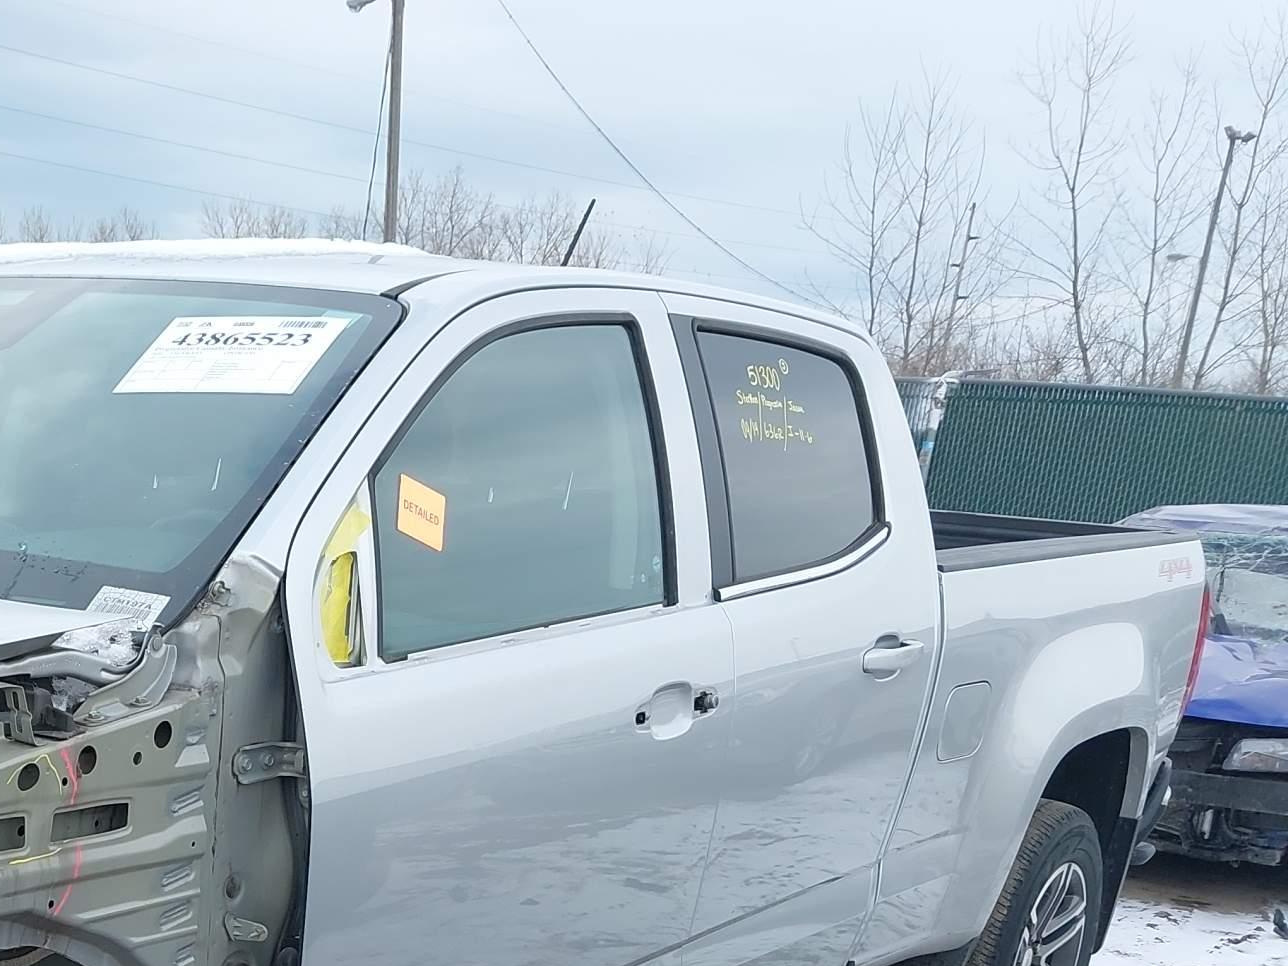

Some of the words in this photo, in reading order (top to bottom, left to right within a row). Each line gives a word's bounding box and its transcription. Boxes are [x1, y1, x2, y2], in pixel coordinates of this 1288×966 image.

[171, 332, 313, 347] 43865523
[747, 365, 780, 391] 51300
[403, 499, 440, 526] DETAILED
